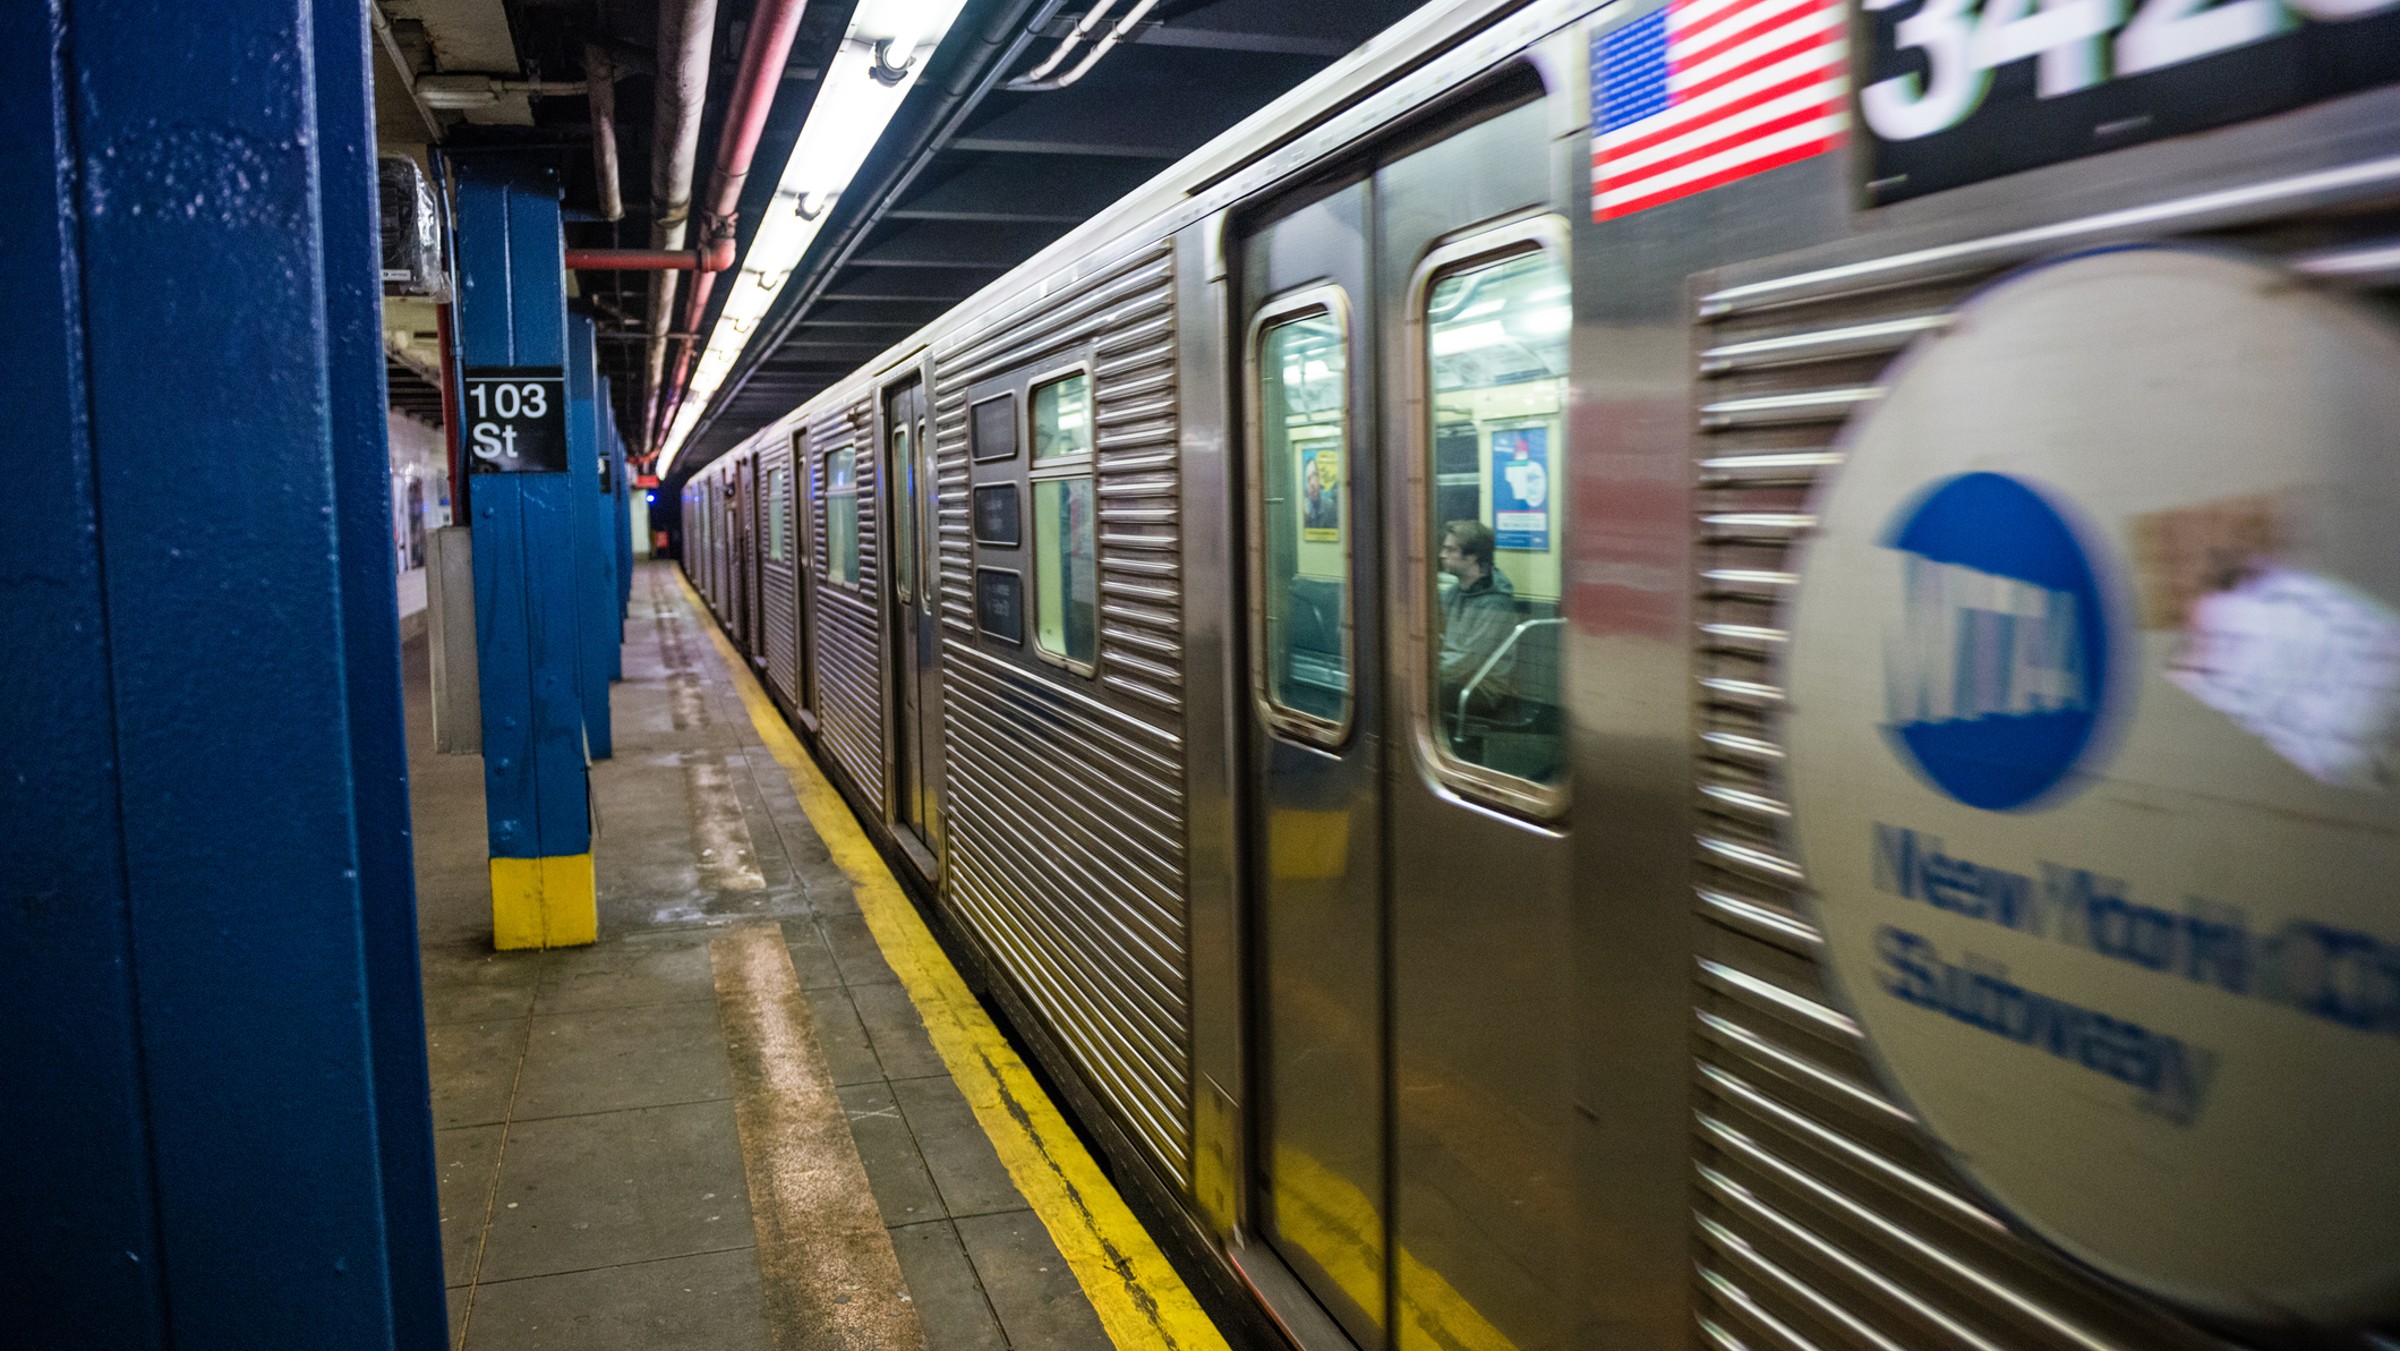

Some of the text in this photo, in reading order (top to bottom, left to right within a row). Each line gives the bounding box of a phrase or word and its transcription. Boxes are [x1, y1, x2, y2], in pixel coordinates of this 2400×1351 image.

[1859, 0, 2400, 141] 34
[470, 383, 547, 419] 103
[472, 423, 518, 459] St
[1873, 922, 2222, 1130] Subway
